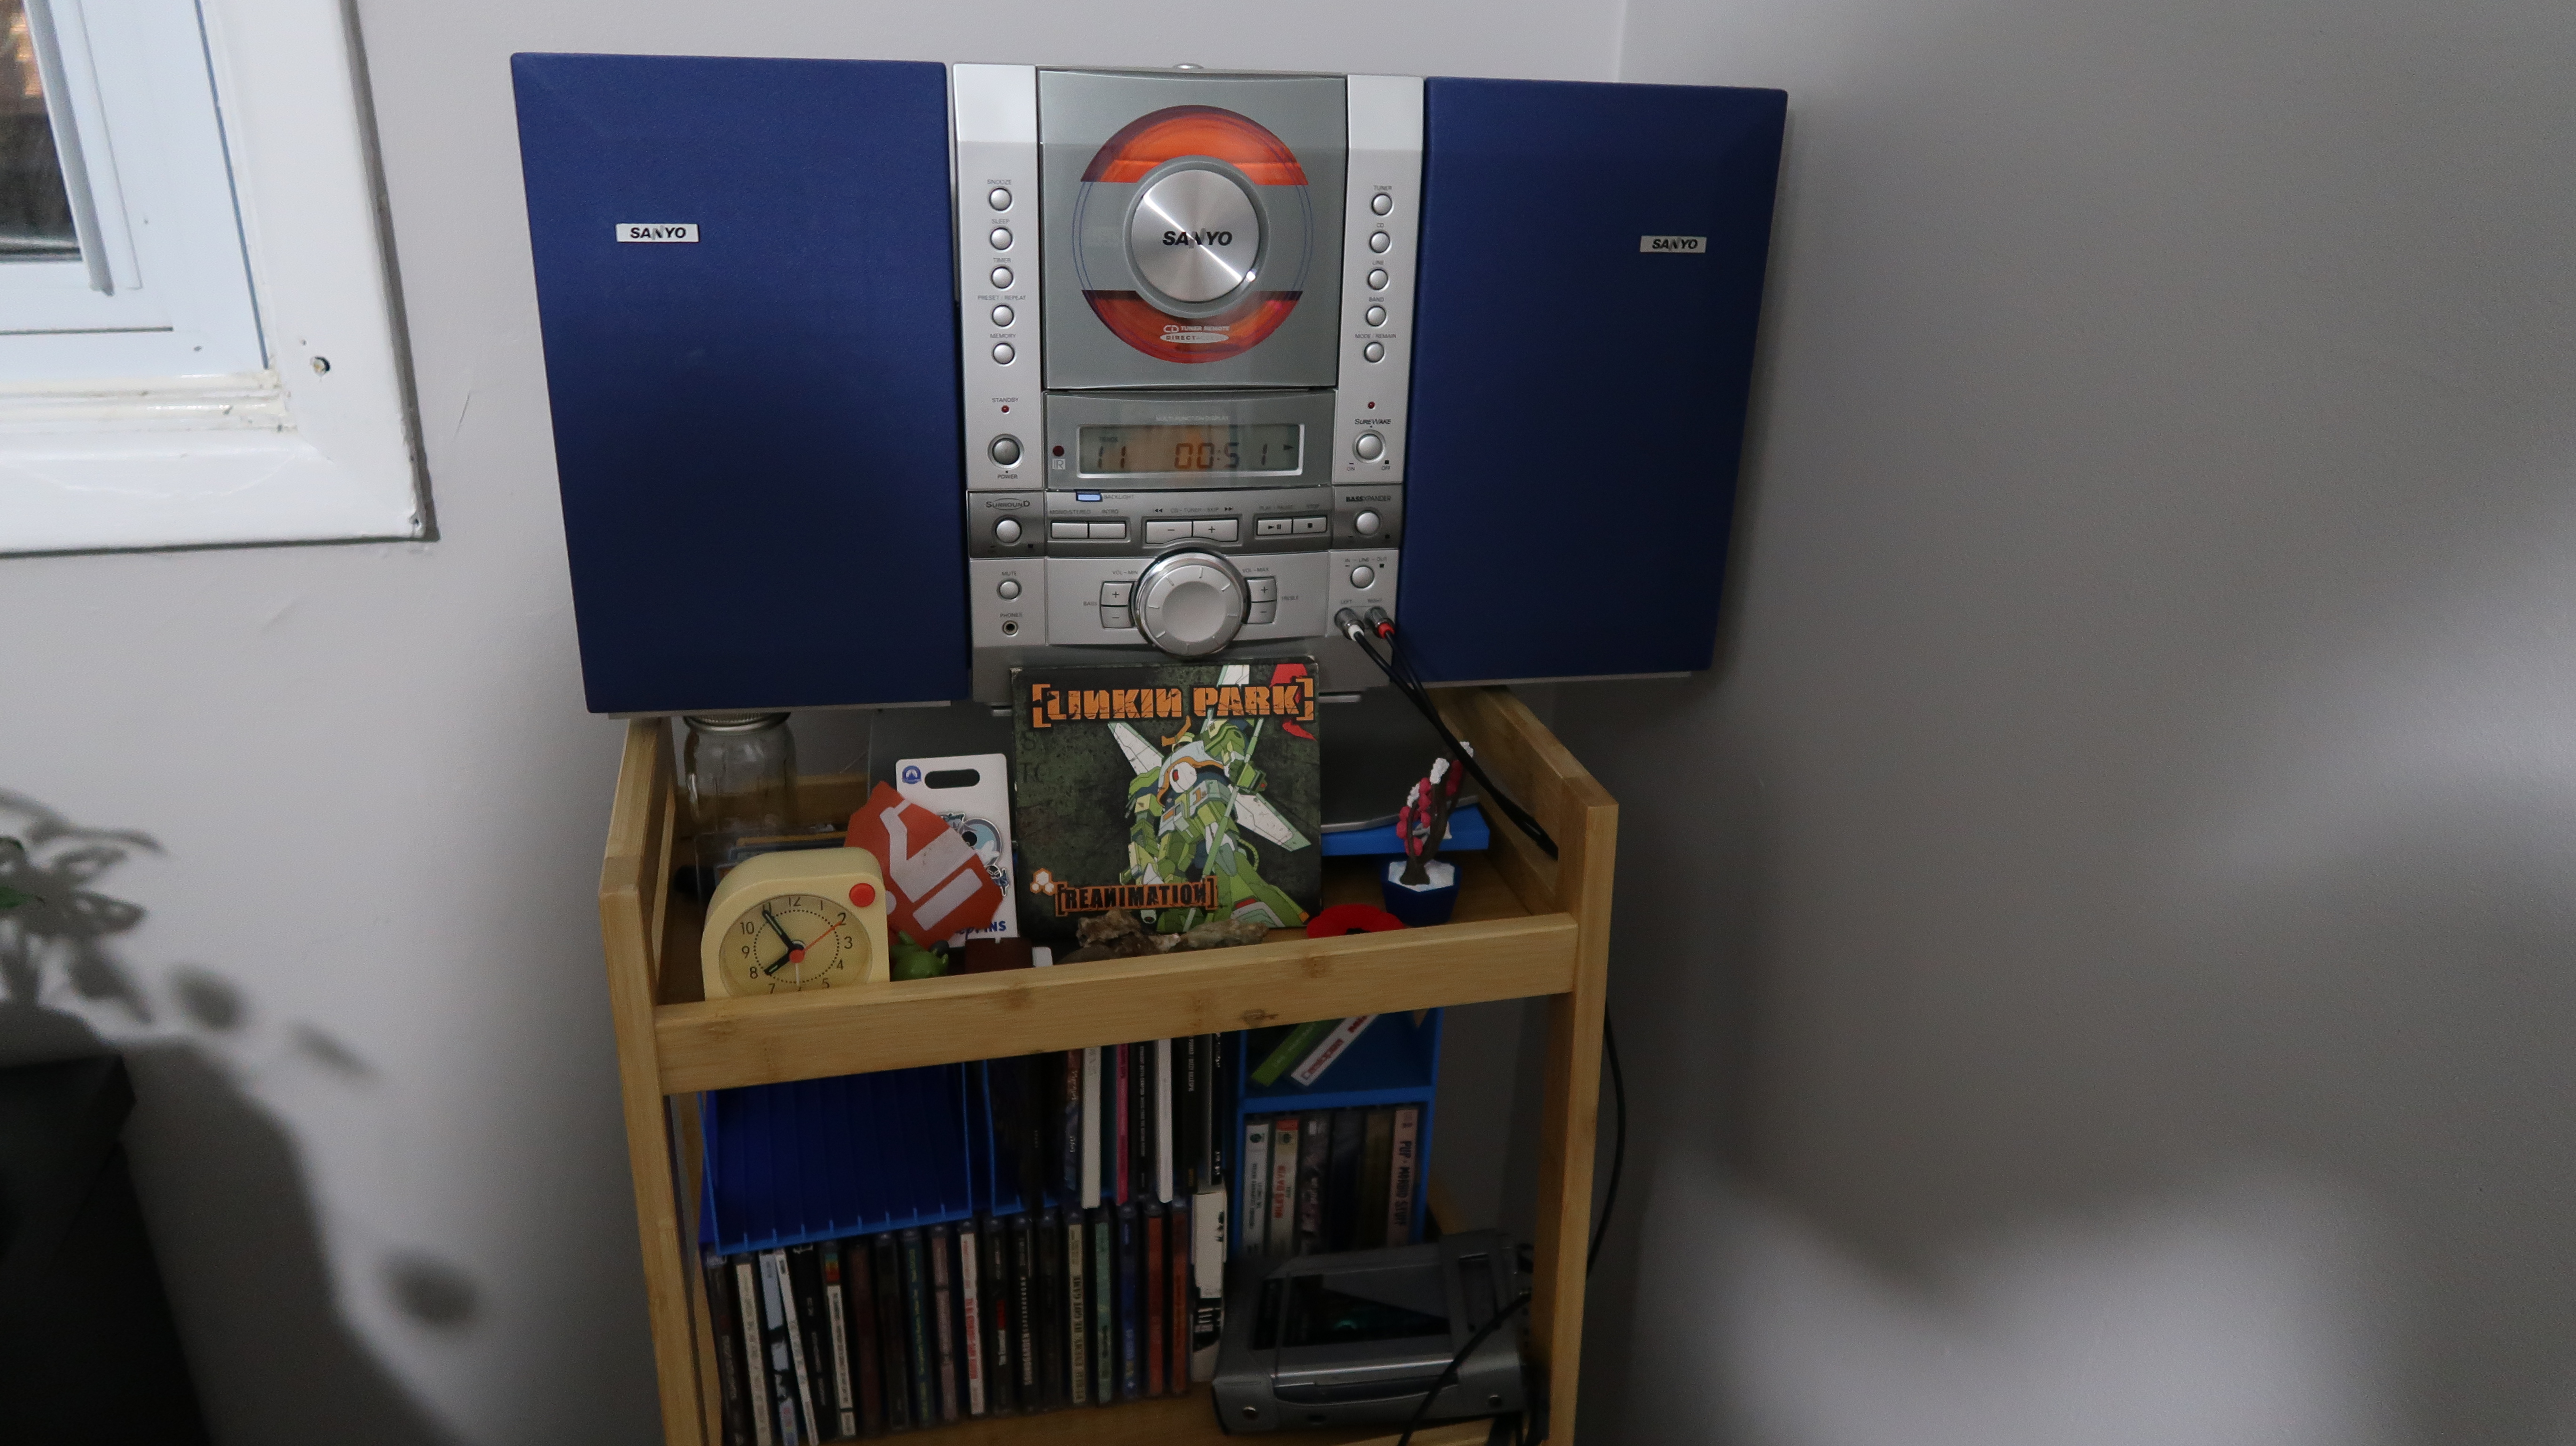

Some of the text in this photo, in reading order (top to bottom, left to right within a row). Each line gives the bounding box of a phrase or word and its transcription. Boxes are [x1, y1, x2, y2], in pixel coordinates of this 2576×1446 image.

[630, 225, 686, 240] SANYO
[1162, 228, 1233, 249] SANYO
[1652, 237, 1698, 250] SANYO
[789, 897, 801, 907] 12
[820, 900, 823, 911] 1
[837, 912, 847, 926] 2
[740, 922, 754, 935] 10
[844, 936, 853, 949] 3
[741, 946, 750, 959] 9
[837, 959, 844, 970] 4
[749, 966, 758, 979] 8
[769, 983, 776, 994] 7
[821, 978, 830, 989] 5
